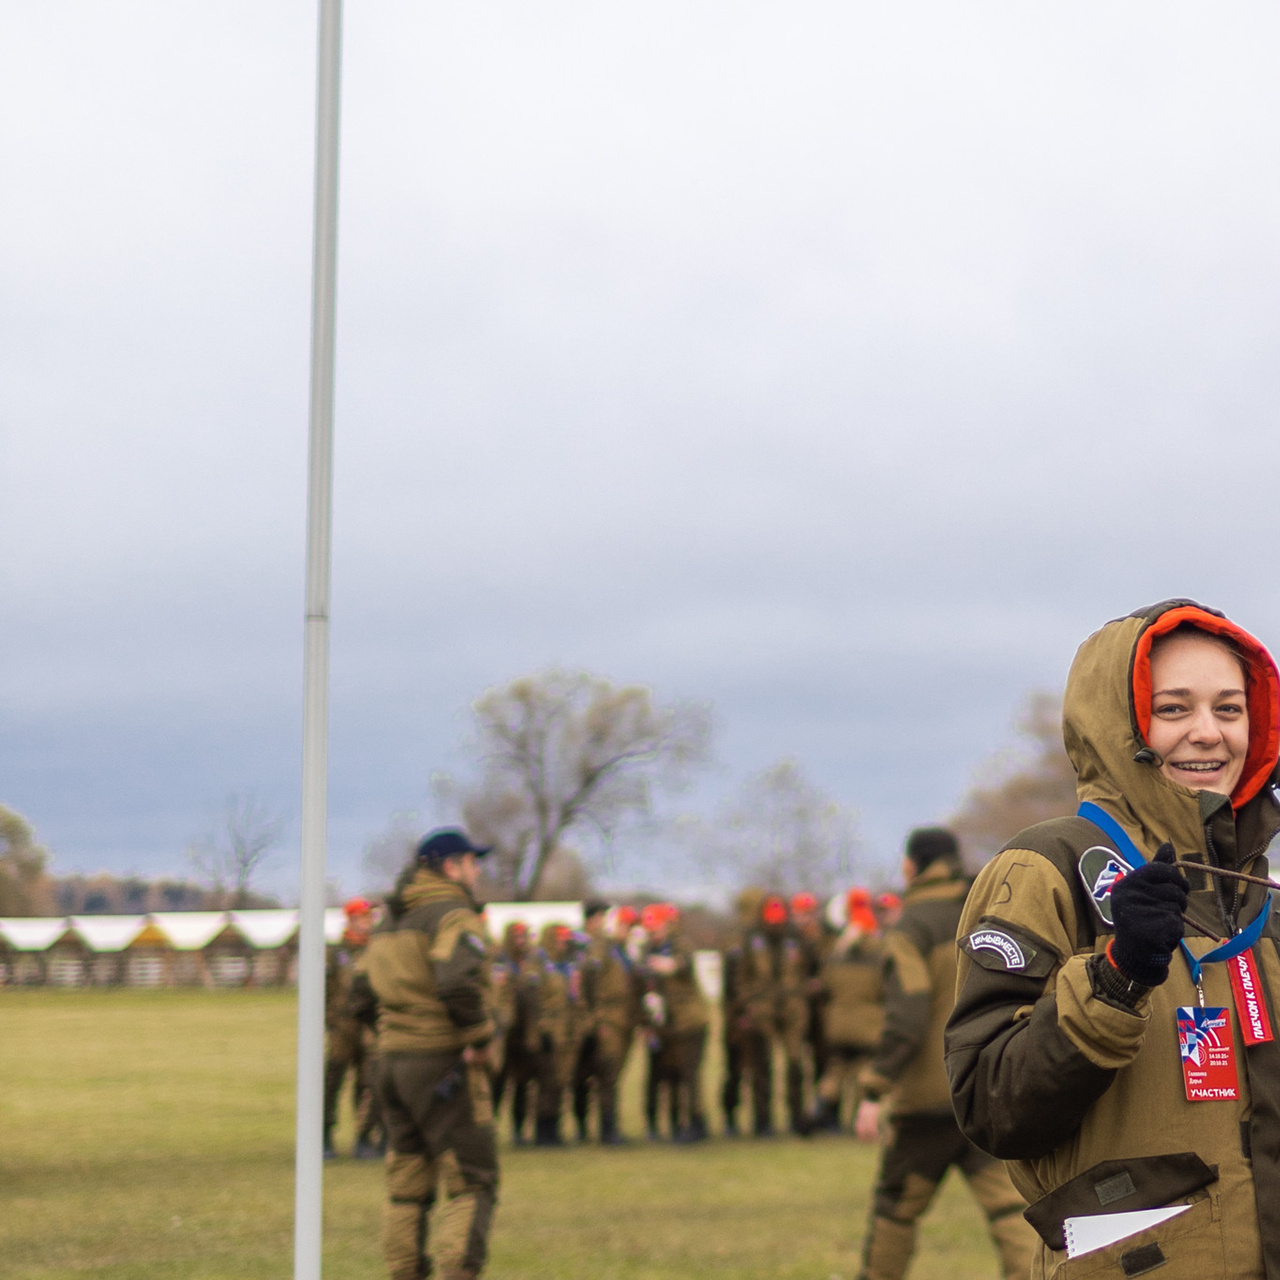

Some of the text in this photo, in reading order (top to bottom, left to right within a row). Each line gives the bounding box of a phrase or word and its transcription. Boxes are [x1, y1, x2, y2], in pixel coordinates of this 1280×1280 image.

[974, 934, 1020, 965] #МЫВМЕСТЕ
[1245, 991, 1256, 999] К
[1246, 1000, 1264, 1039] ПЛЕЧОМ
[1190, 1088, 1236, 1098] УЧАСТНИК
